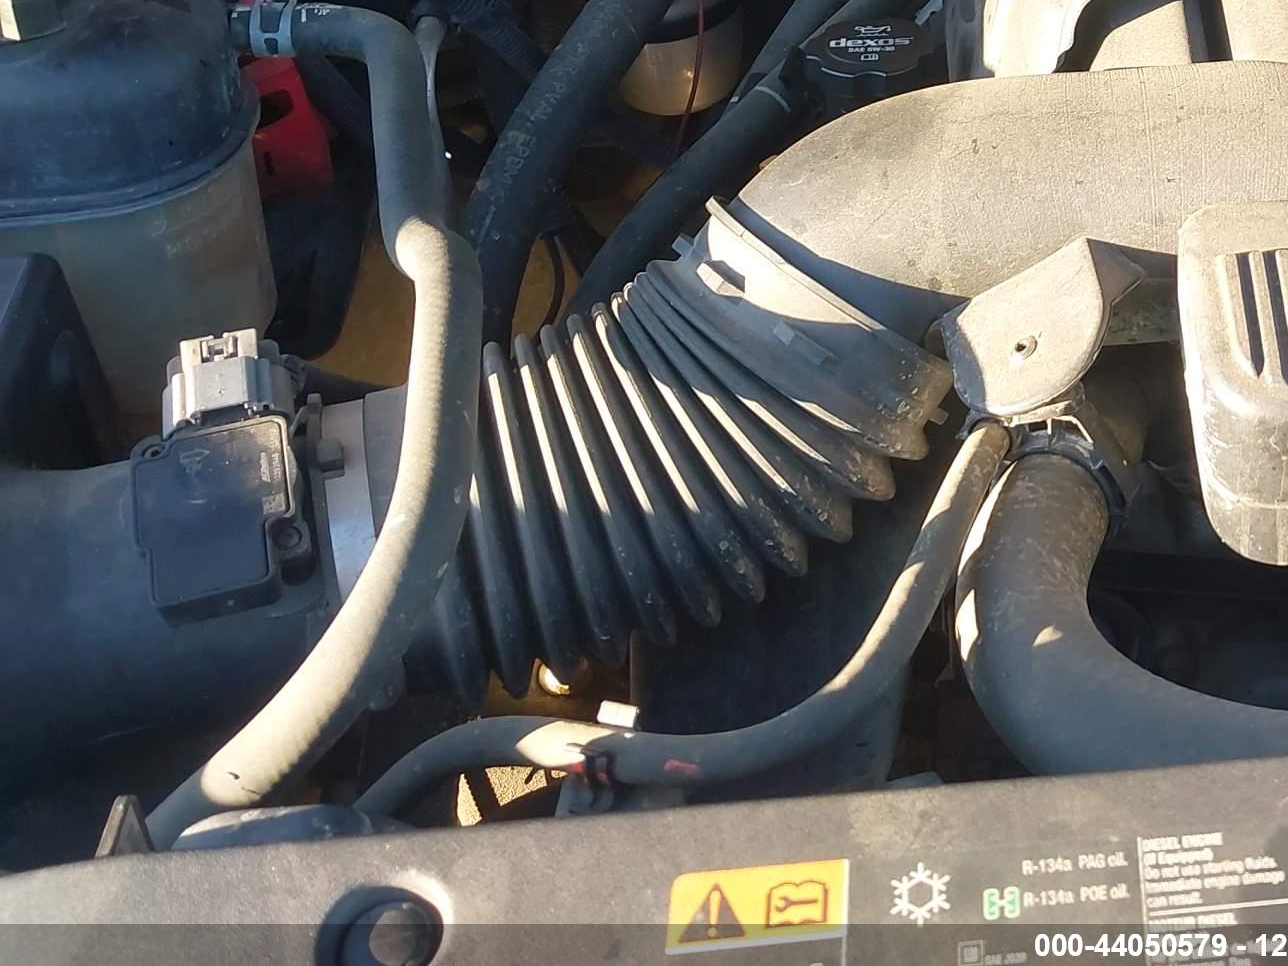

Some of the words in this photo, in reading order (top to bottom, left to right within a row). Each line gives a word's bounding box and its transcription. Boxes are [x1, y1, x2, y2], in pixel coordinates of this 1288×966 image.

[828, 36, 915, 48] dexos
[1022, 856, 1073, 875] R-134a
[1078, 853, 1106, 869] PAG
[1023, 889, 1075, 908] R-134a
[1080, 884, 1108, 902] POE
